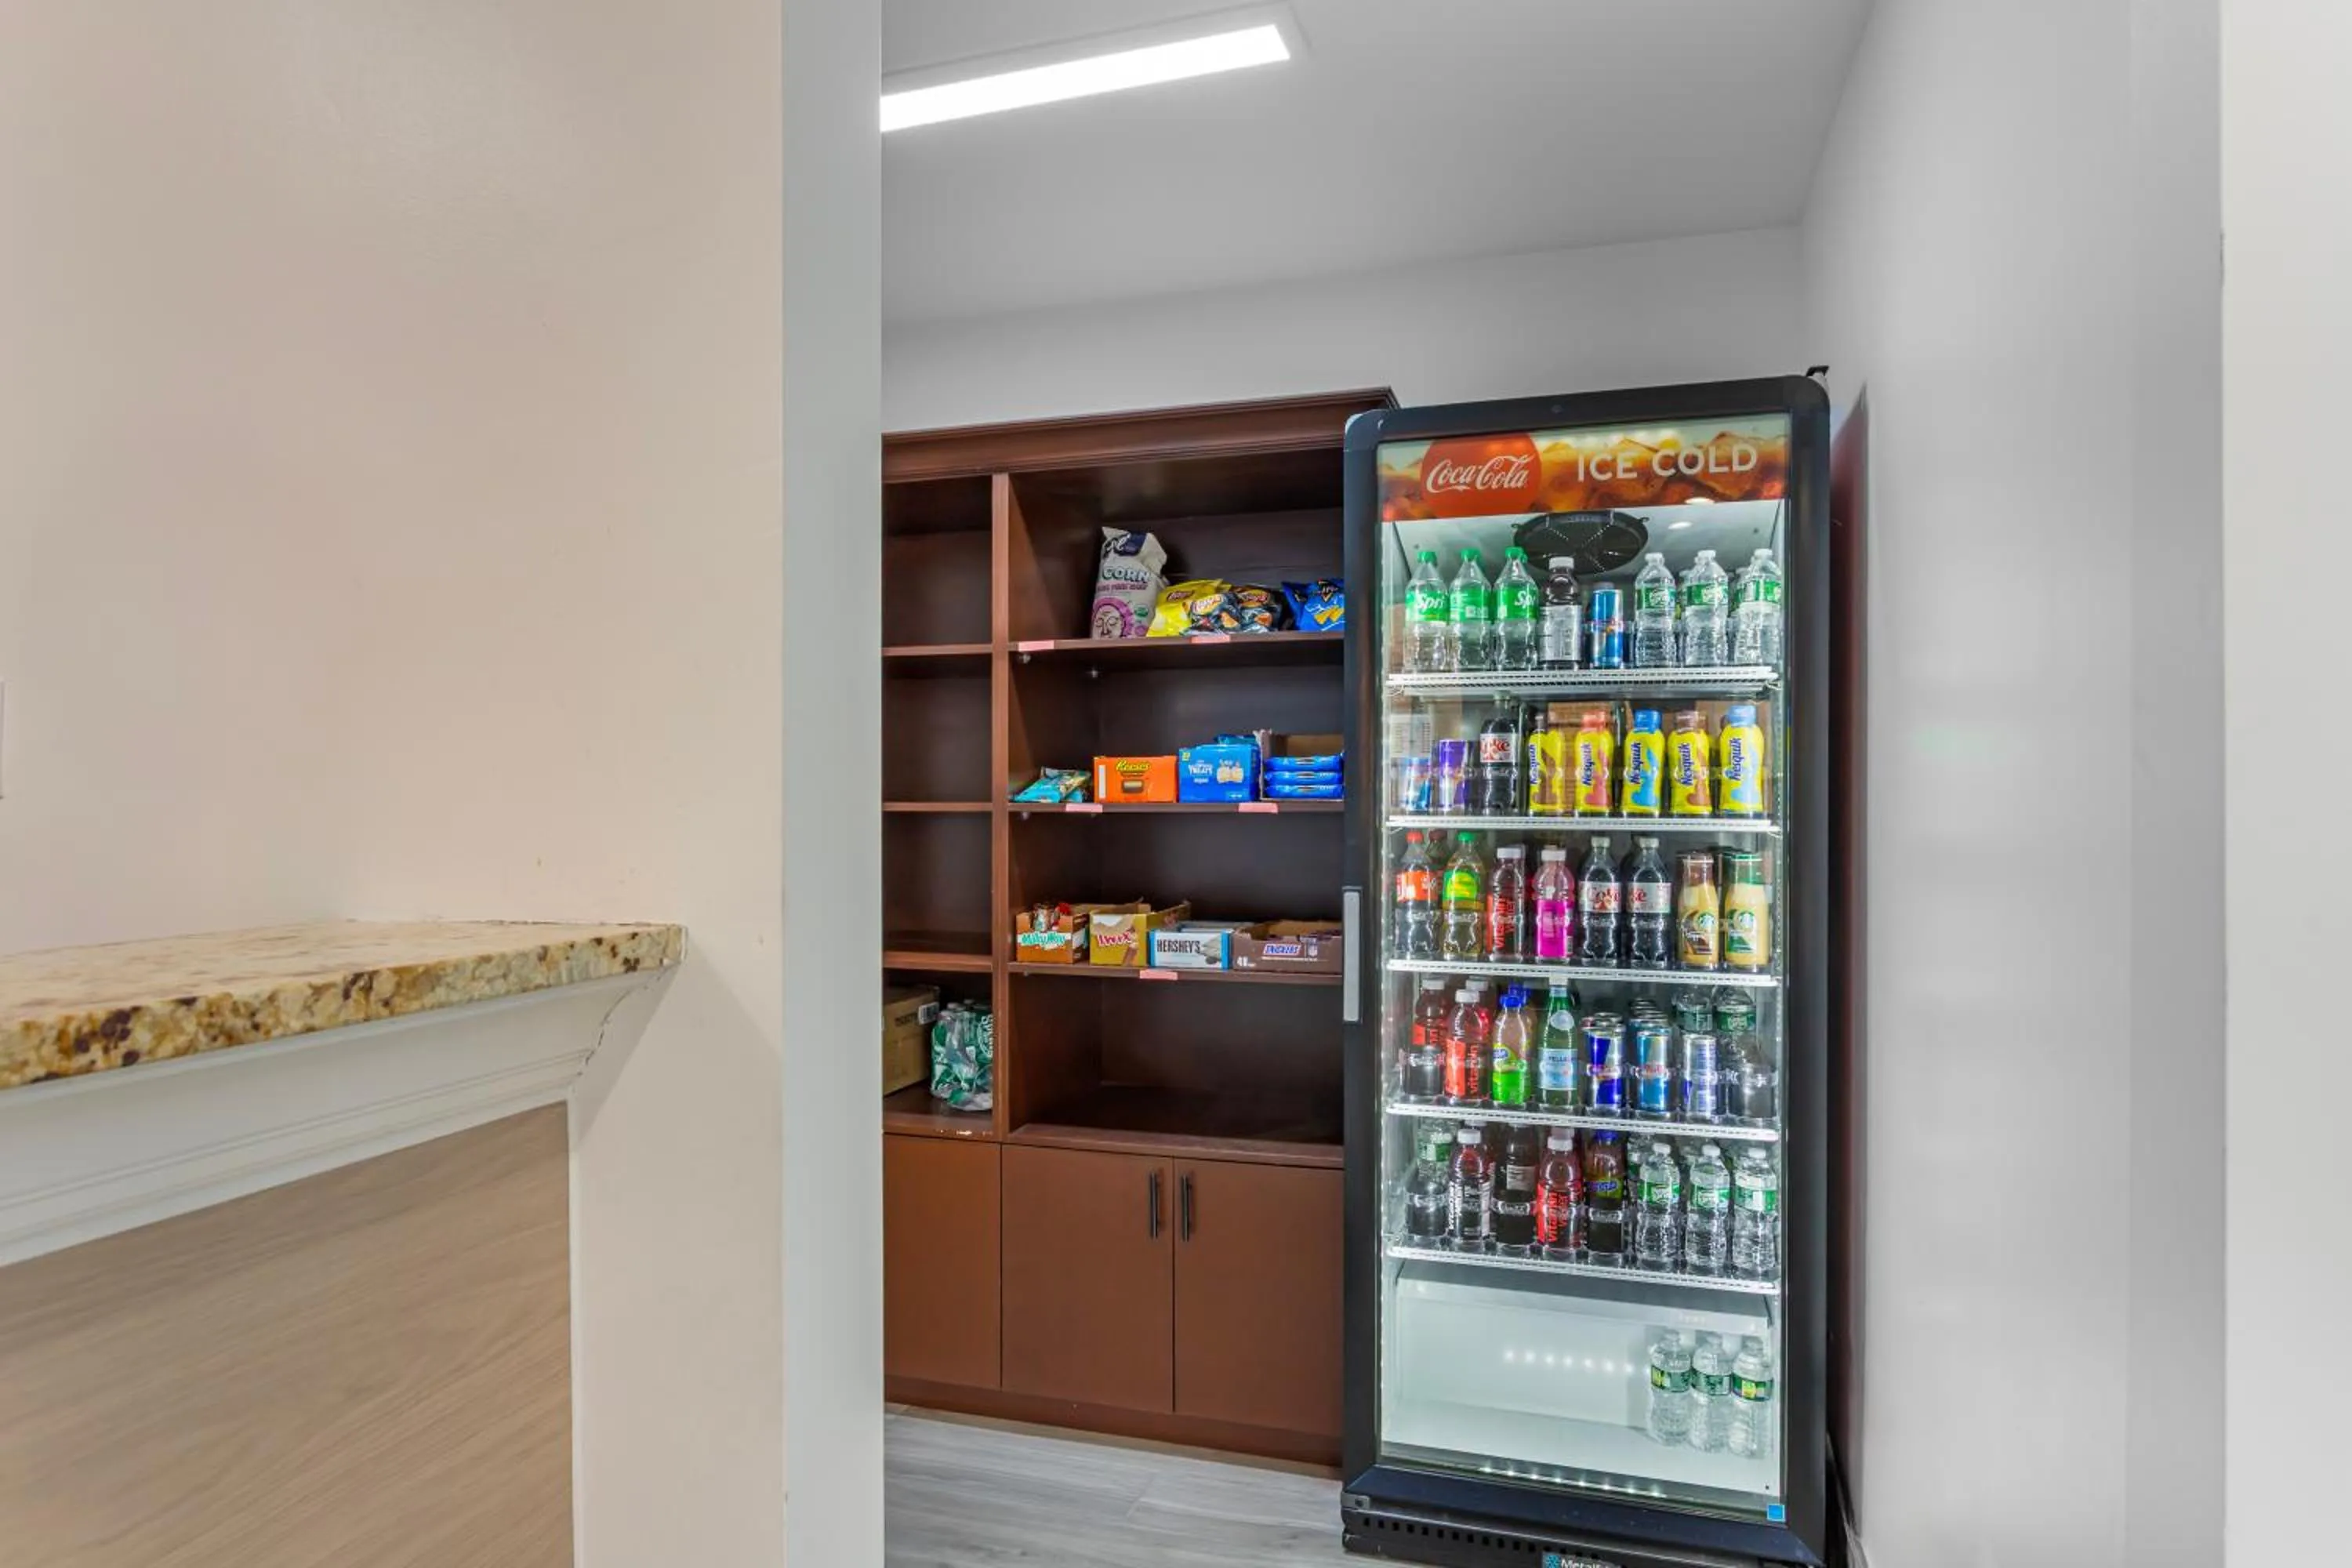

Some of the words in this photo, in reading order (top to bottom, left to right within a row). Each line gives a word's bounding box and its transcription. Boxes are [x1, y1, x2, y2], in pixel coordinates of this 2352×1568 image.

[1426, 455, 1534, 492] Coca-Cola
[1577, 456, 1639, 483] ICE
[1652, 445, 1758, 477] COLD
[1103, 566, 1149, 582] CORN
[1157, 938, 1201, 954] HERSHEY'S
